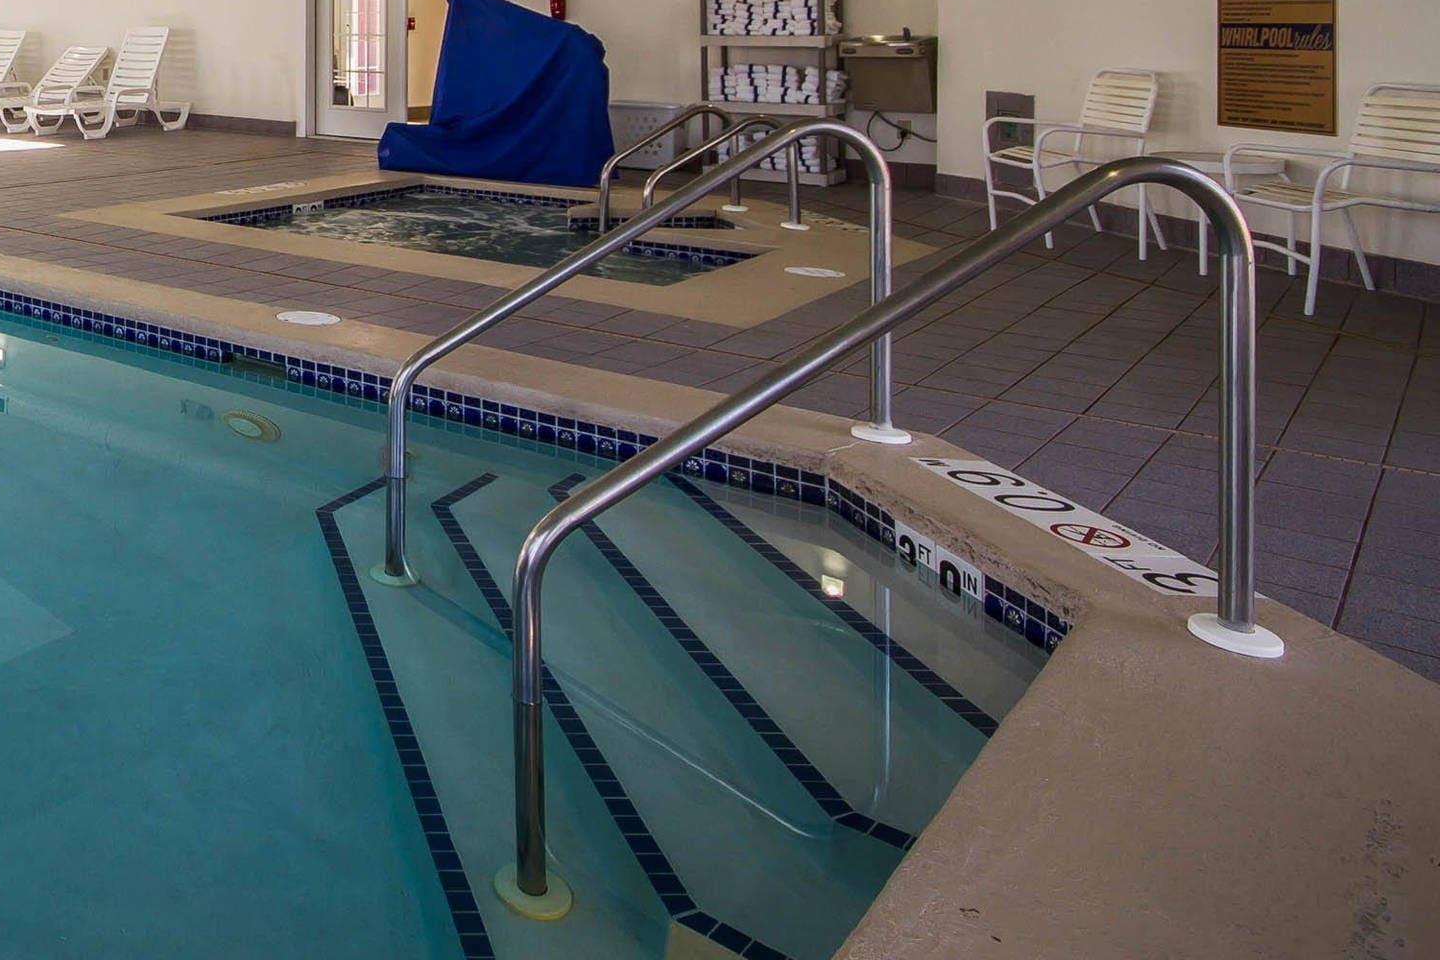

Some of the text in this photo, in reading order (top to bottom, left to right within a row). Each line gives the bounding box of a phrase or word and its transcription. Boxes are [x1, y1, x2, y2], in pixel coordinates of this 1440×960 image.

[1221, 24, 1332, 50] WHIRLPOOL rules
[919, 543, 932, 566] FT
[963, 570, 978, 596] IN
[1103, 556, 1152, 571] FT
